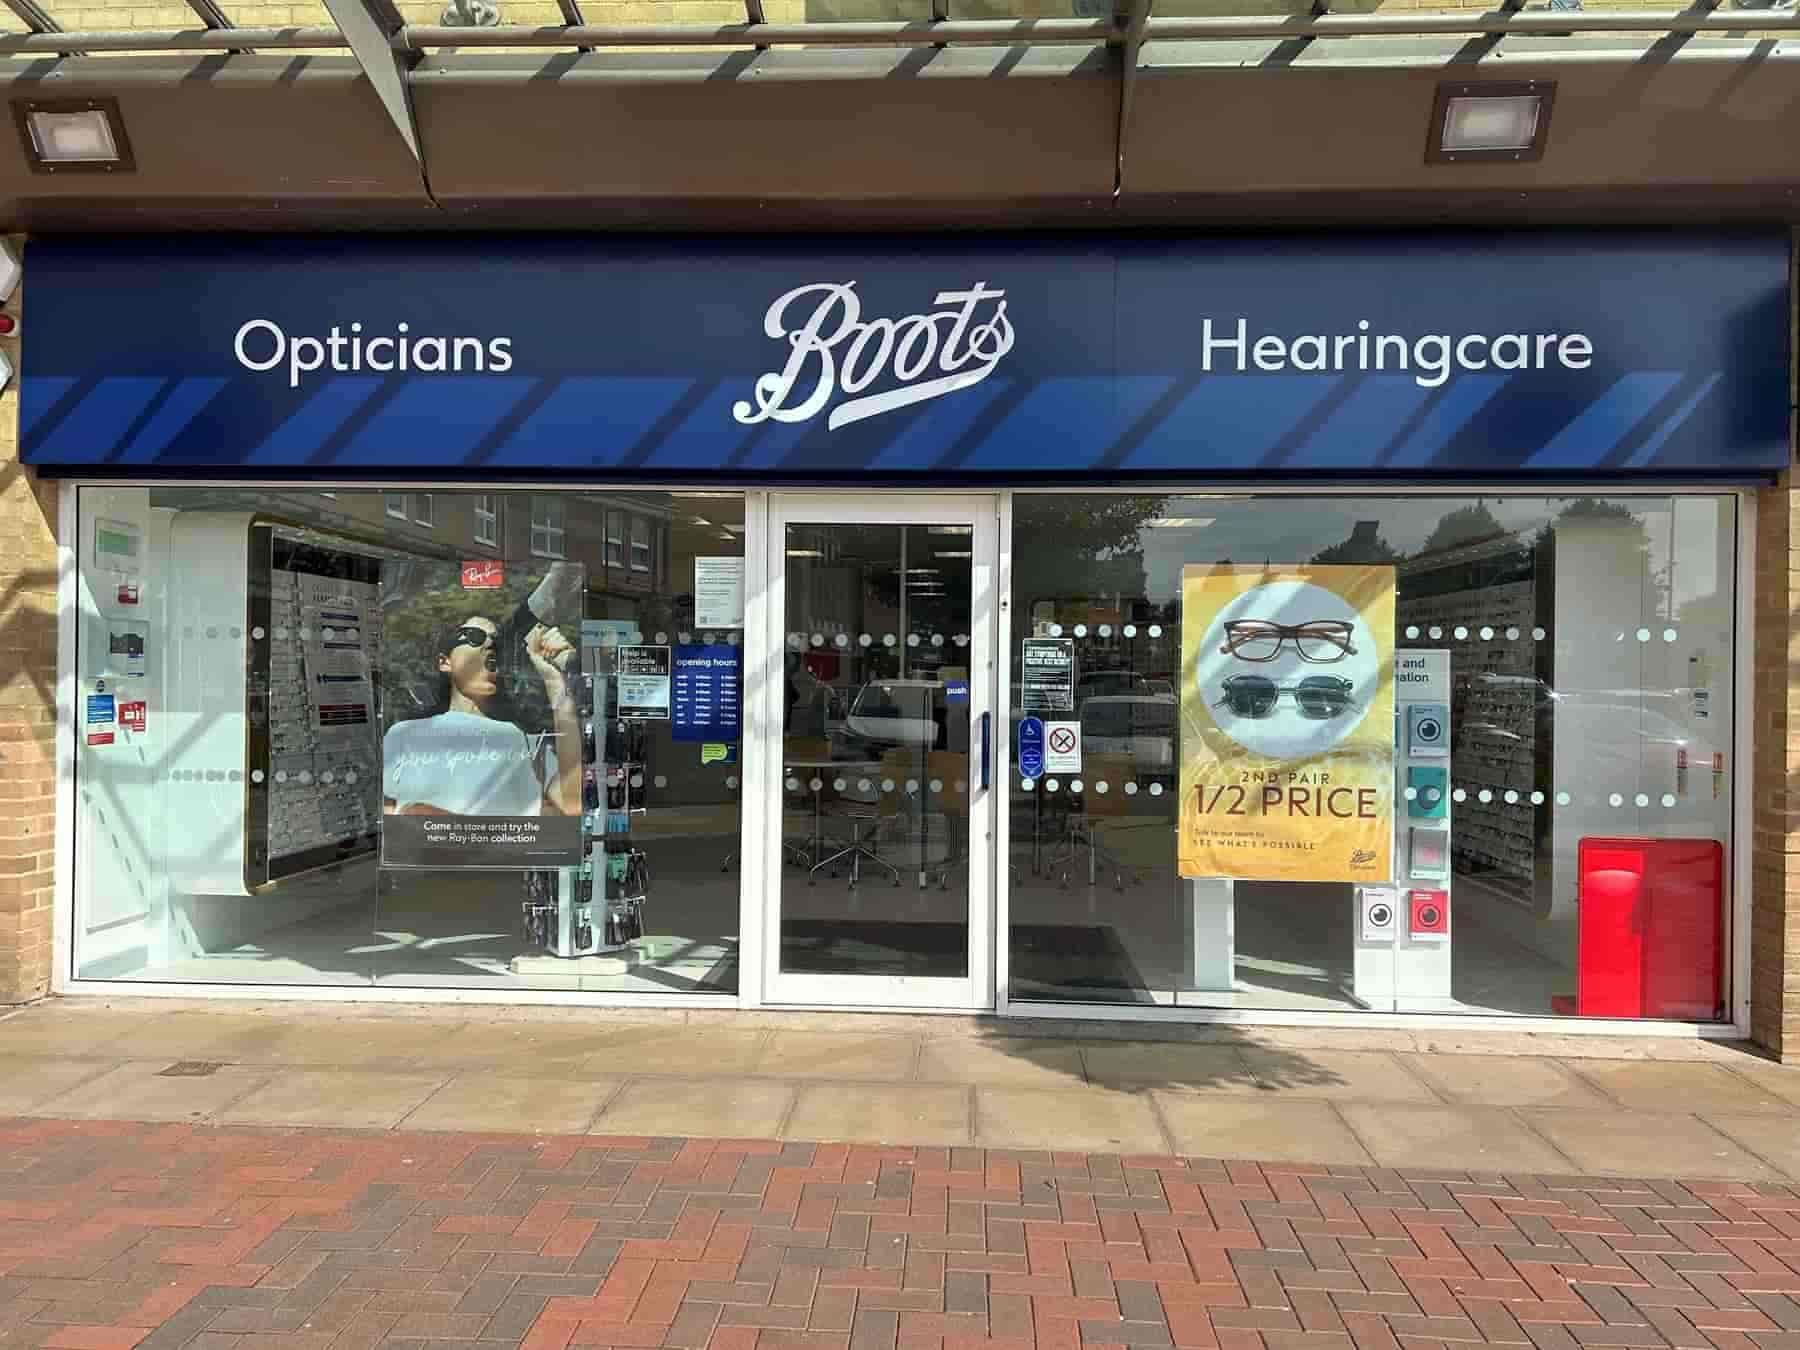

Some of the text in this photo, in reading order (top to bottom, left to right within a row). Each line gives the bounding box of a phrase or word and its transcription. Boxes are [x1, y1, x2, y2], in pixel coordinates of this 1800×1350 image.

[234, 319, 513, 387] Opticians
[732, 281, 1015, 430] Boots
[1201, 318, 1593, 388] Hearingcare
[676, 658, 737, 668] opening hours
[1403, 657, 1425, 668] and
[946, 686, 967, 696] push
[1241, 771, 1330, 784] 2ND PAIR
[1193, 784, 1377, 818] 1/2 PRICE
[423, 821, 540, 833] Come in store and try the
[448, 833, 489, 845] Ray-Ban
[490, 833, 536, 843] collection
[1263, 841, 1316, 850] POSSIBLE
